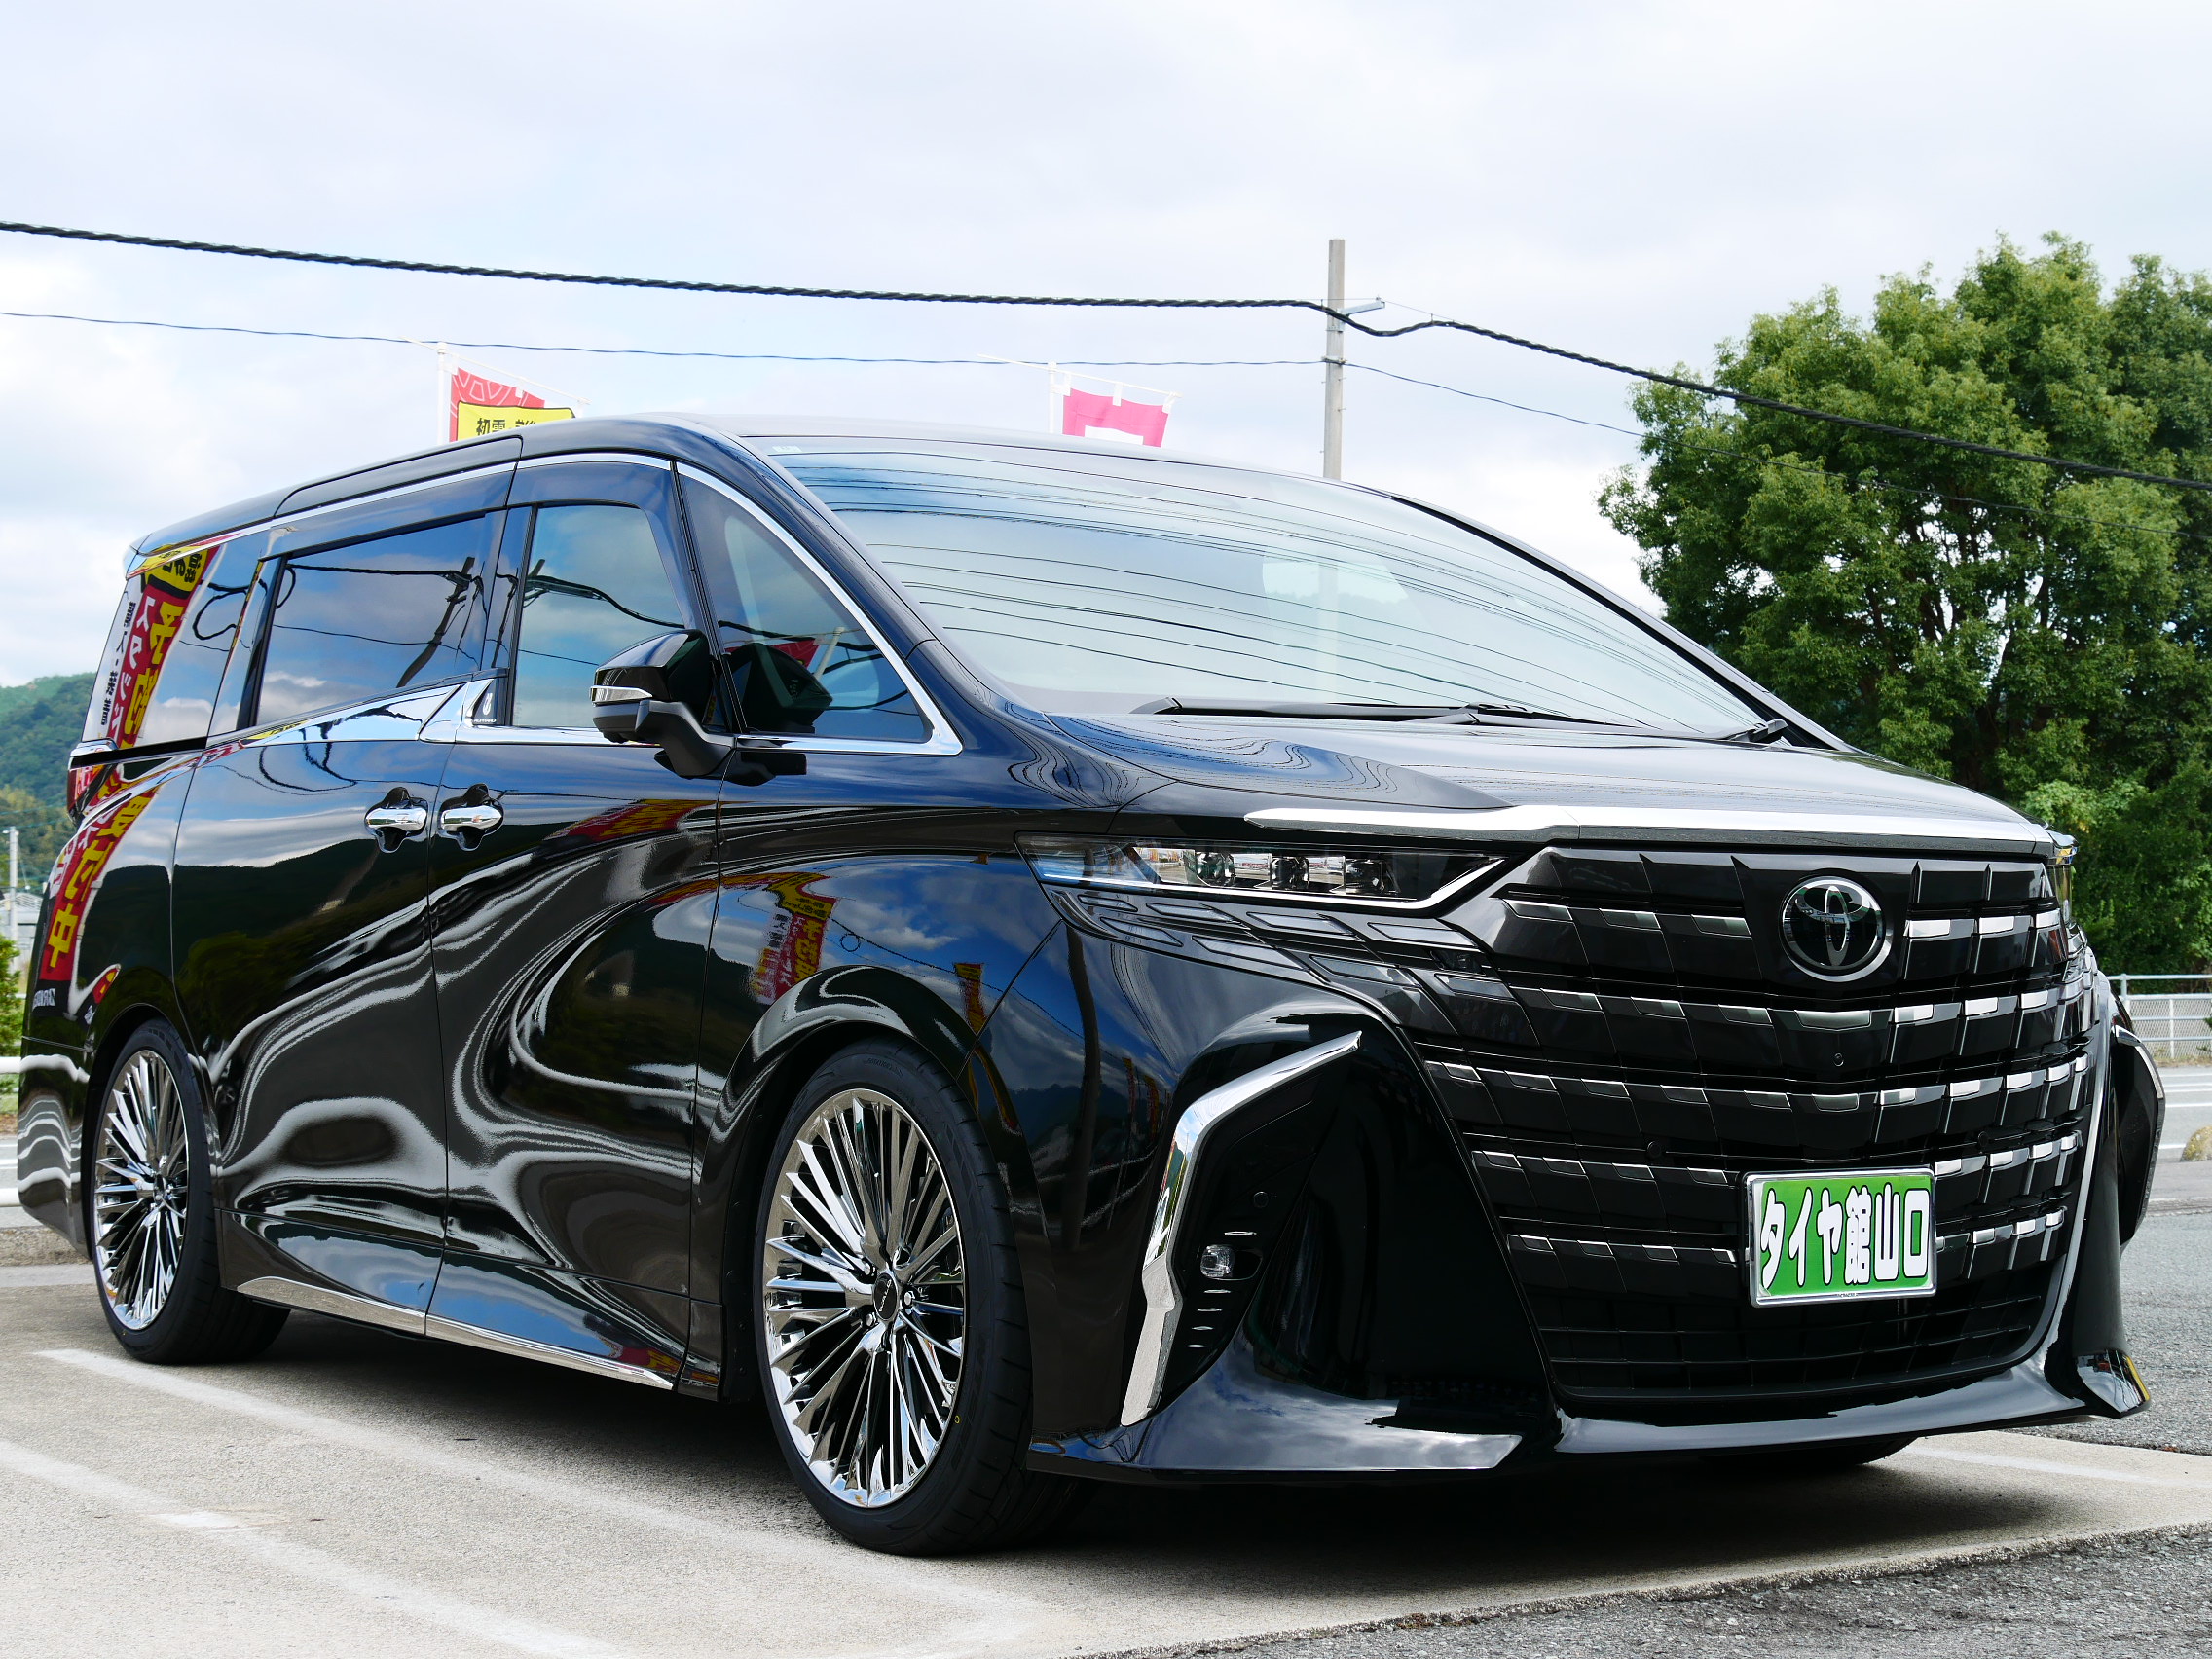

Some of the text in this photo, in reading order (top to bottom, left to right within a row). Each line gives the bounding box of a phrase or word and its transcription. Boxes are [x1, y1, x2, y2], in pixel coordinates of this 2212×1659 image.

[1760, 1182, 1930, 1290] タイヤ館山口
